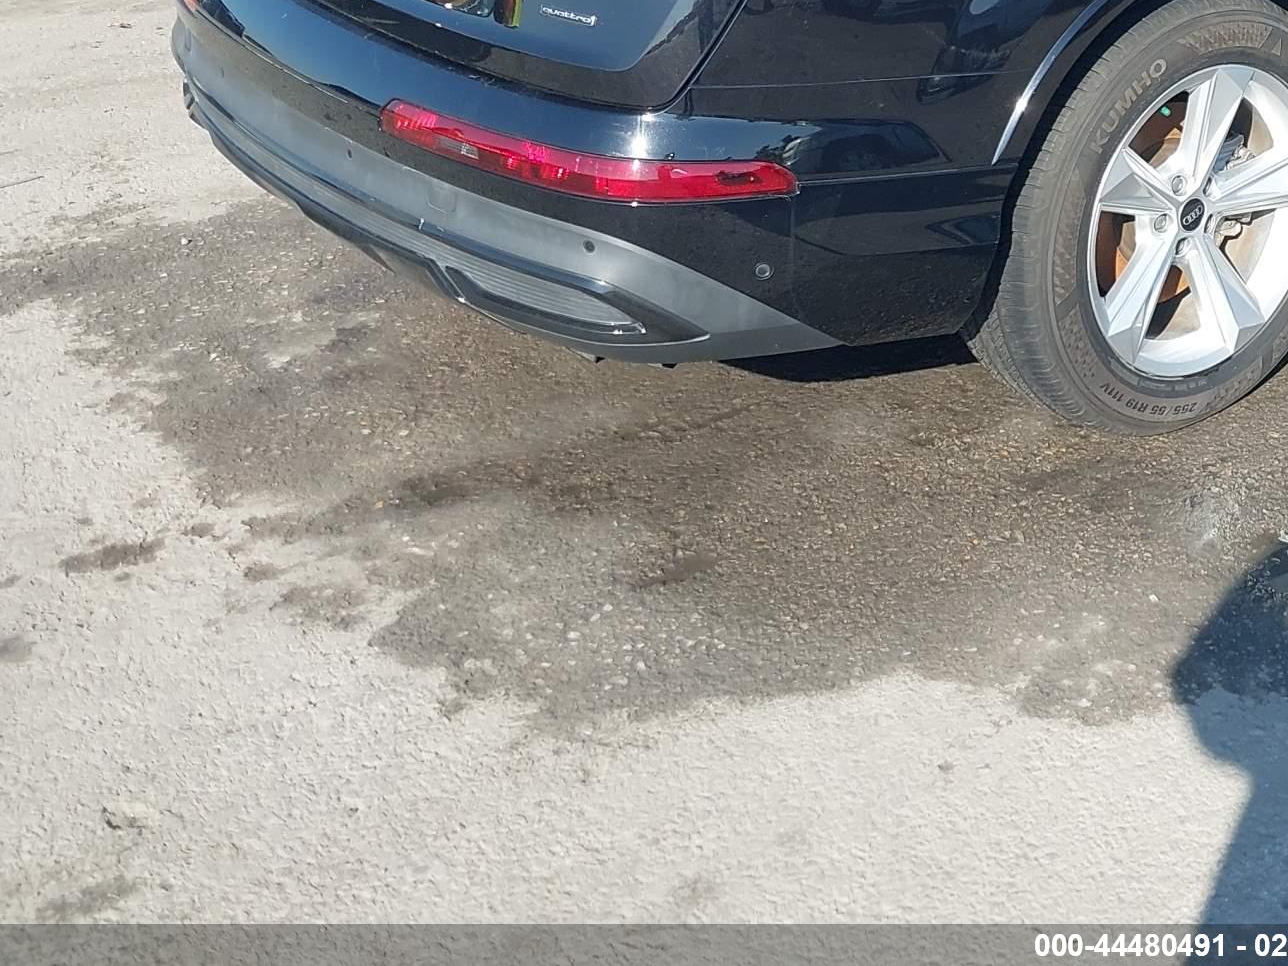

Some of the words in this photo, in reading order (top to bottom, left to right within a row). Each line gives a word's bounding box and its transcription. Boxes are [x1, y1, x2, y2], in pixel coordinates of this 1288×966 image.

[1088, 58, 1168, 154] KUMHO
[1099, 381, 1124, 403] 111V
[1125, 398, 1149, 414] R19
[1148, 401, 1199, 416] 255/55
